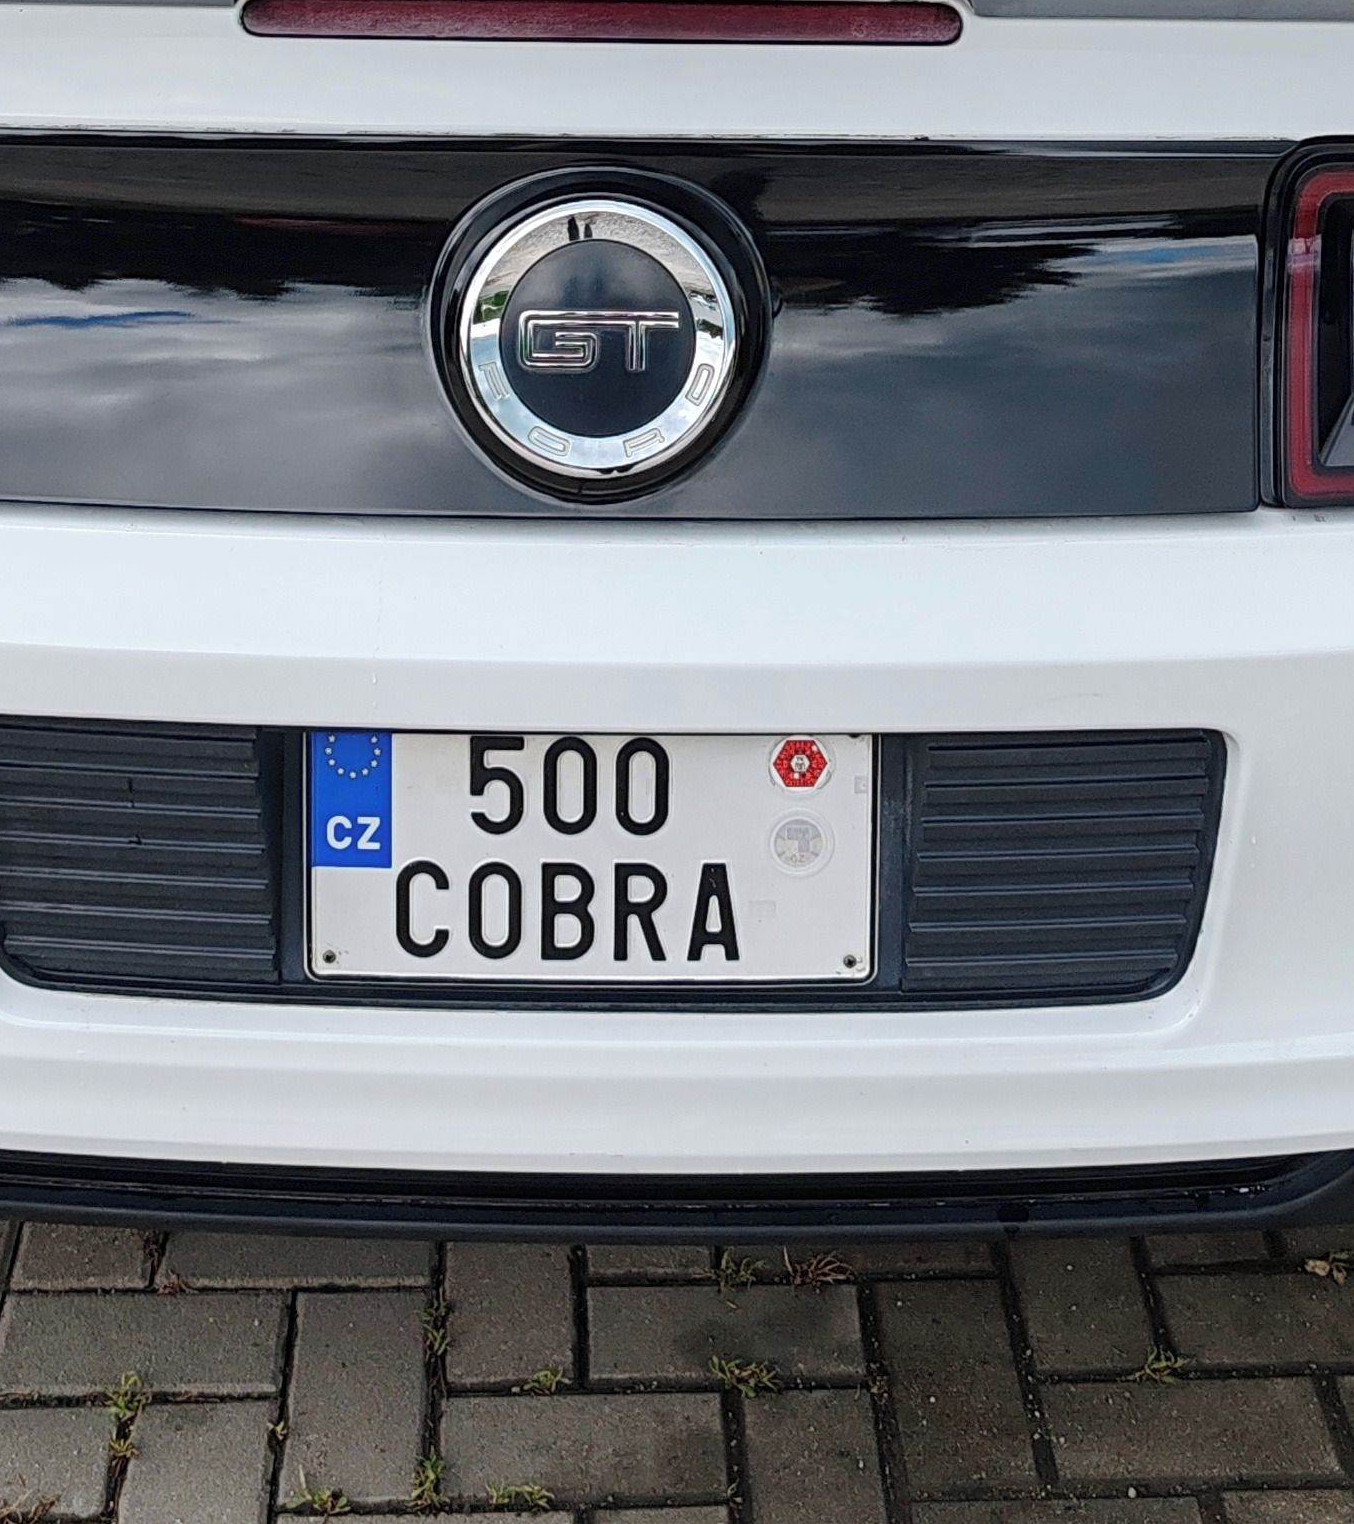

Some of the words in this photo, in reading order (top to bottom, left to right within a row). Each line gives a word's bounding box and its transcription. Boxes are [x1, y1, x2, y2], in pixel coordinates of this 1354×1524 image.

[519, 310, 680, 371] GT
[470, 736, 670, 835] 500
[326, 815, 381, 850] CZ
[395, 860, 741, 961] COBRA
